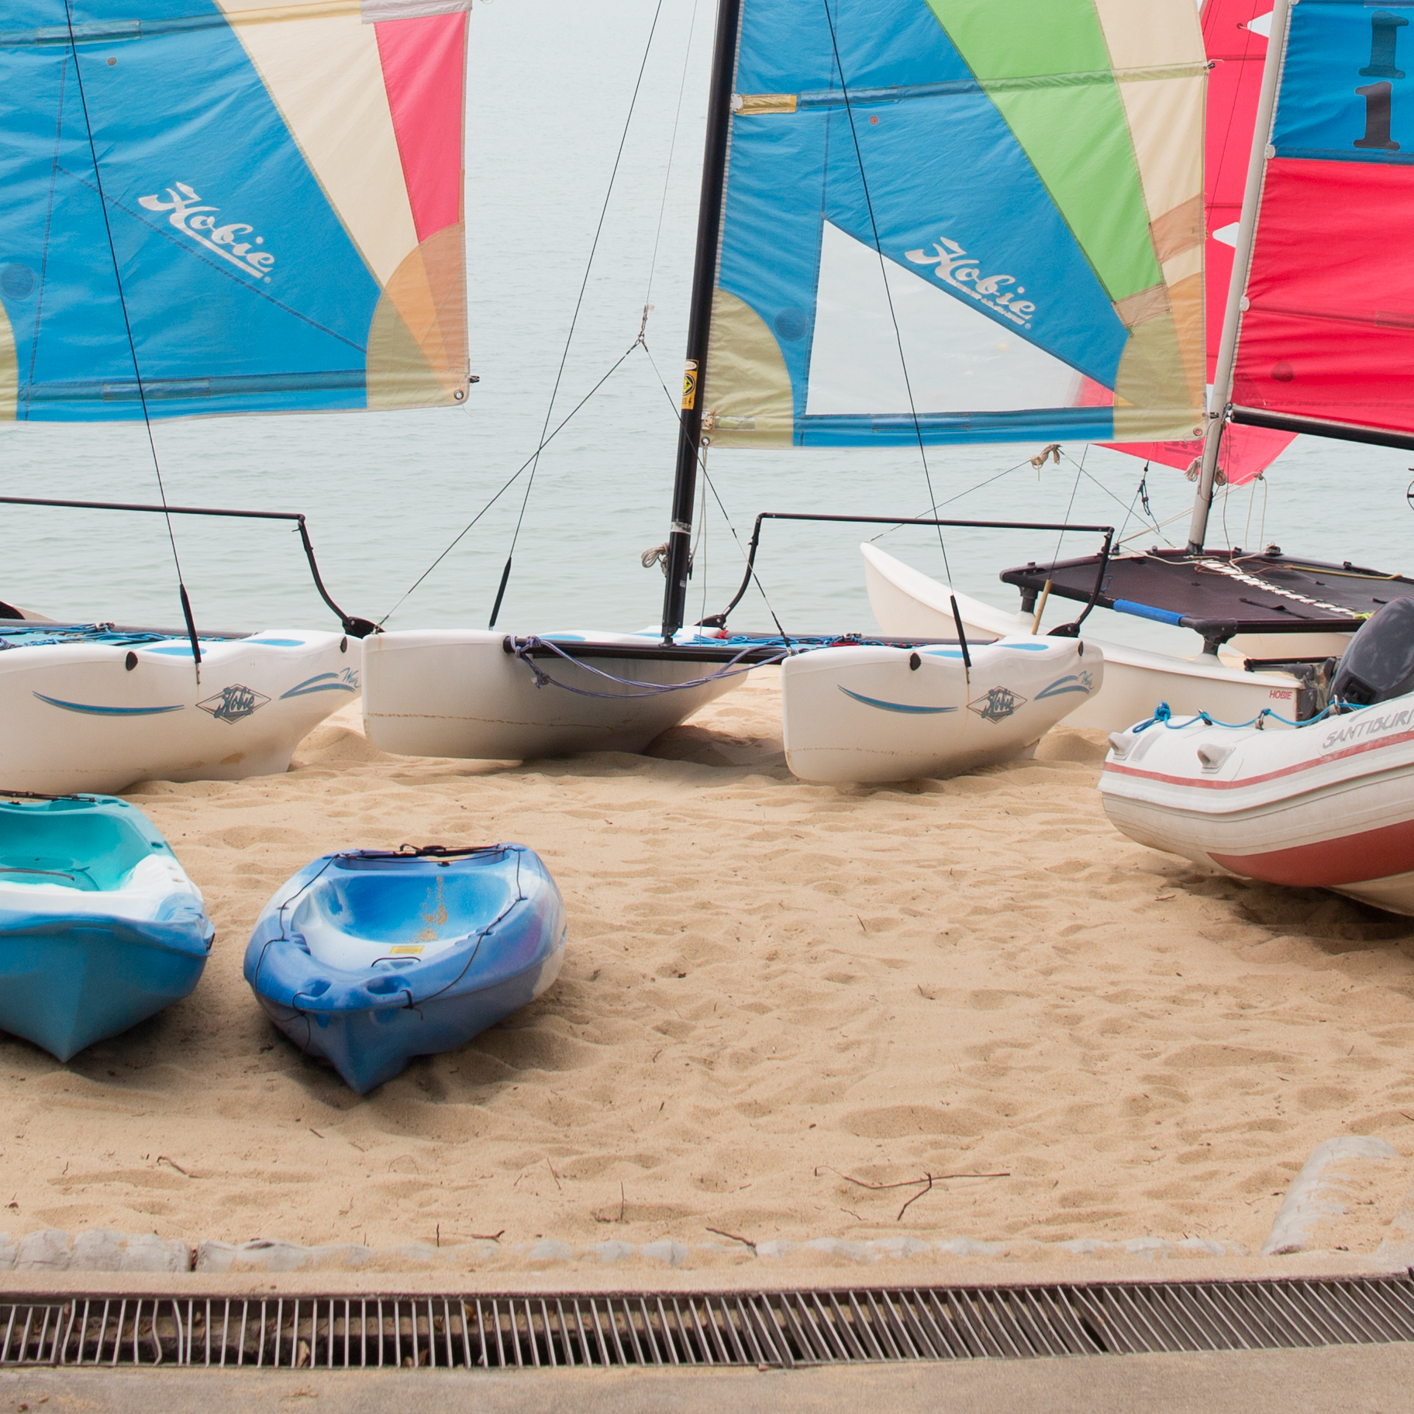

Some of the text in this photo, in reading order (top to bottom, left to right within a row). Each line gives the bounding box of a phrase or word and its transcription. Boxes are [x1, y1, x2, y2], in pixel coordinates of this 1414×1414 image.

[137, 181, 276, 280] Hobie
[904, 236, 1036, 325] Hobie
[214, 686, 255, 718] Hobie
[1269, 690, 1292, 700] HOBIE
